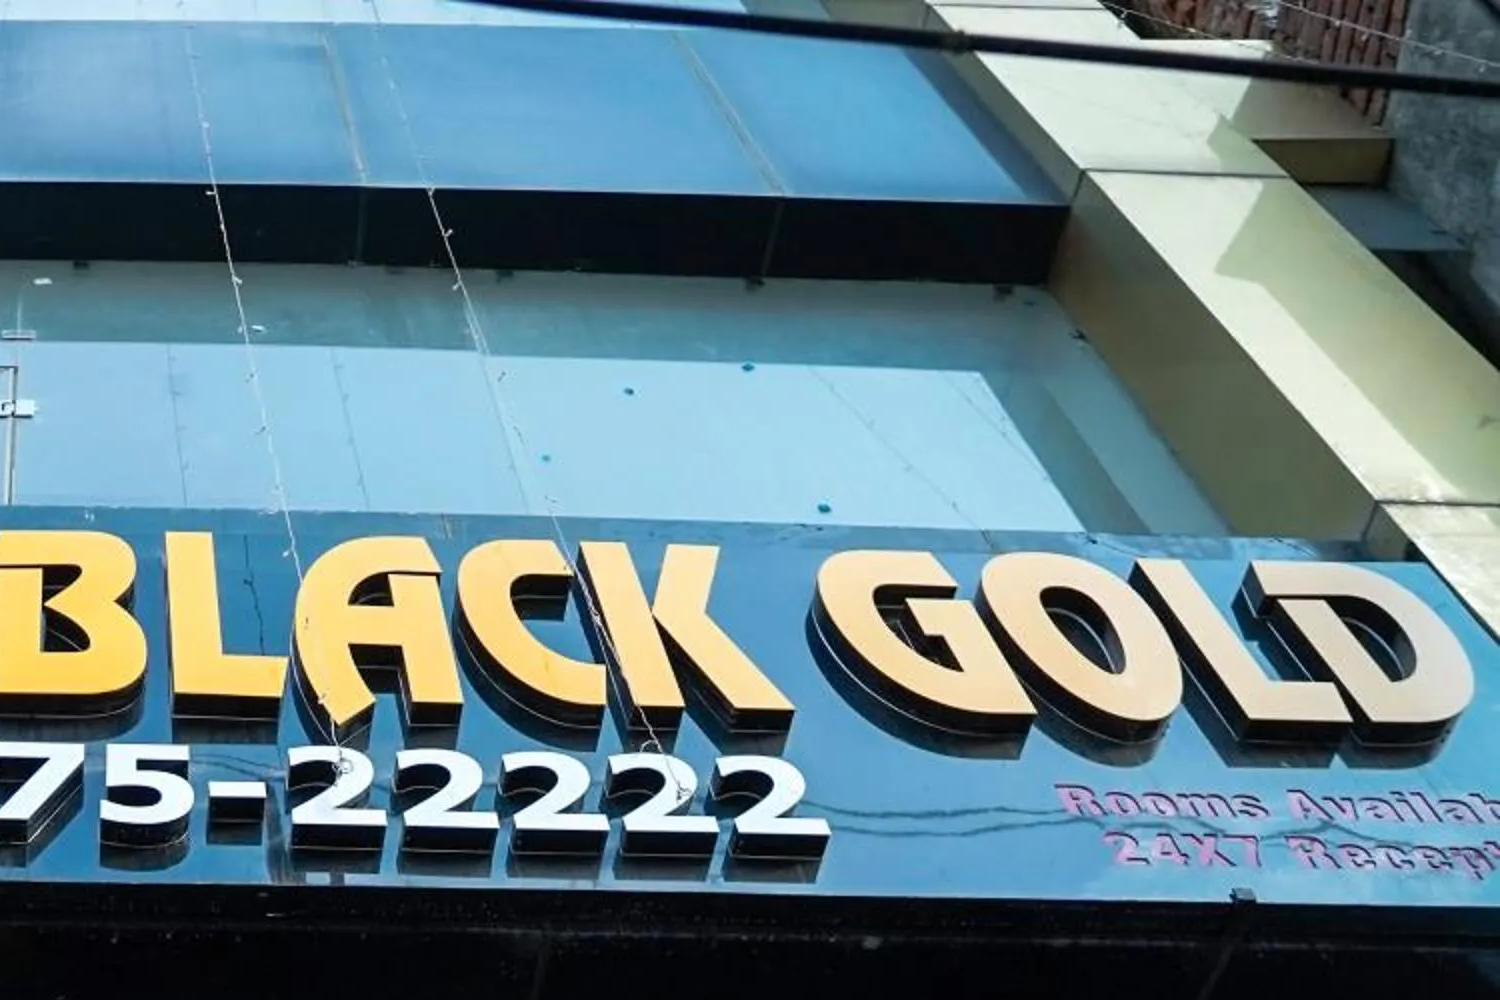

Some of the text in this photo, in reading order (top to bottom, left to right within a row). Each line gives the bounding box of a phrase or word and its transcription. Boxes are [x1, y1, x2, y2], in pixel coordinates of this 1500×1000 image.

[815, 550, 1475, 723] GOLD
[1054, 784, 1271, 817] Rooms
[1103, 831, 1263, 867] 24X7
